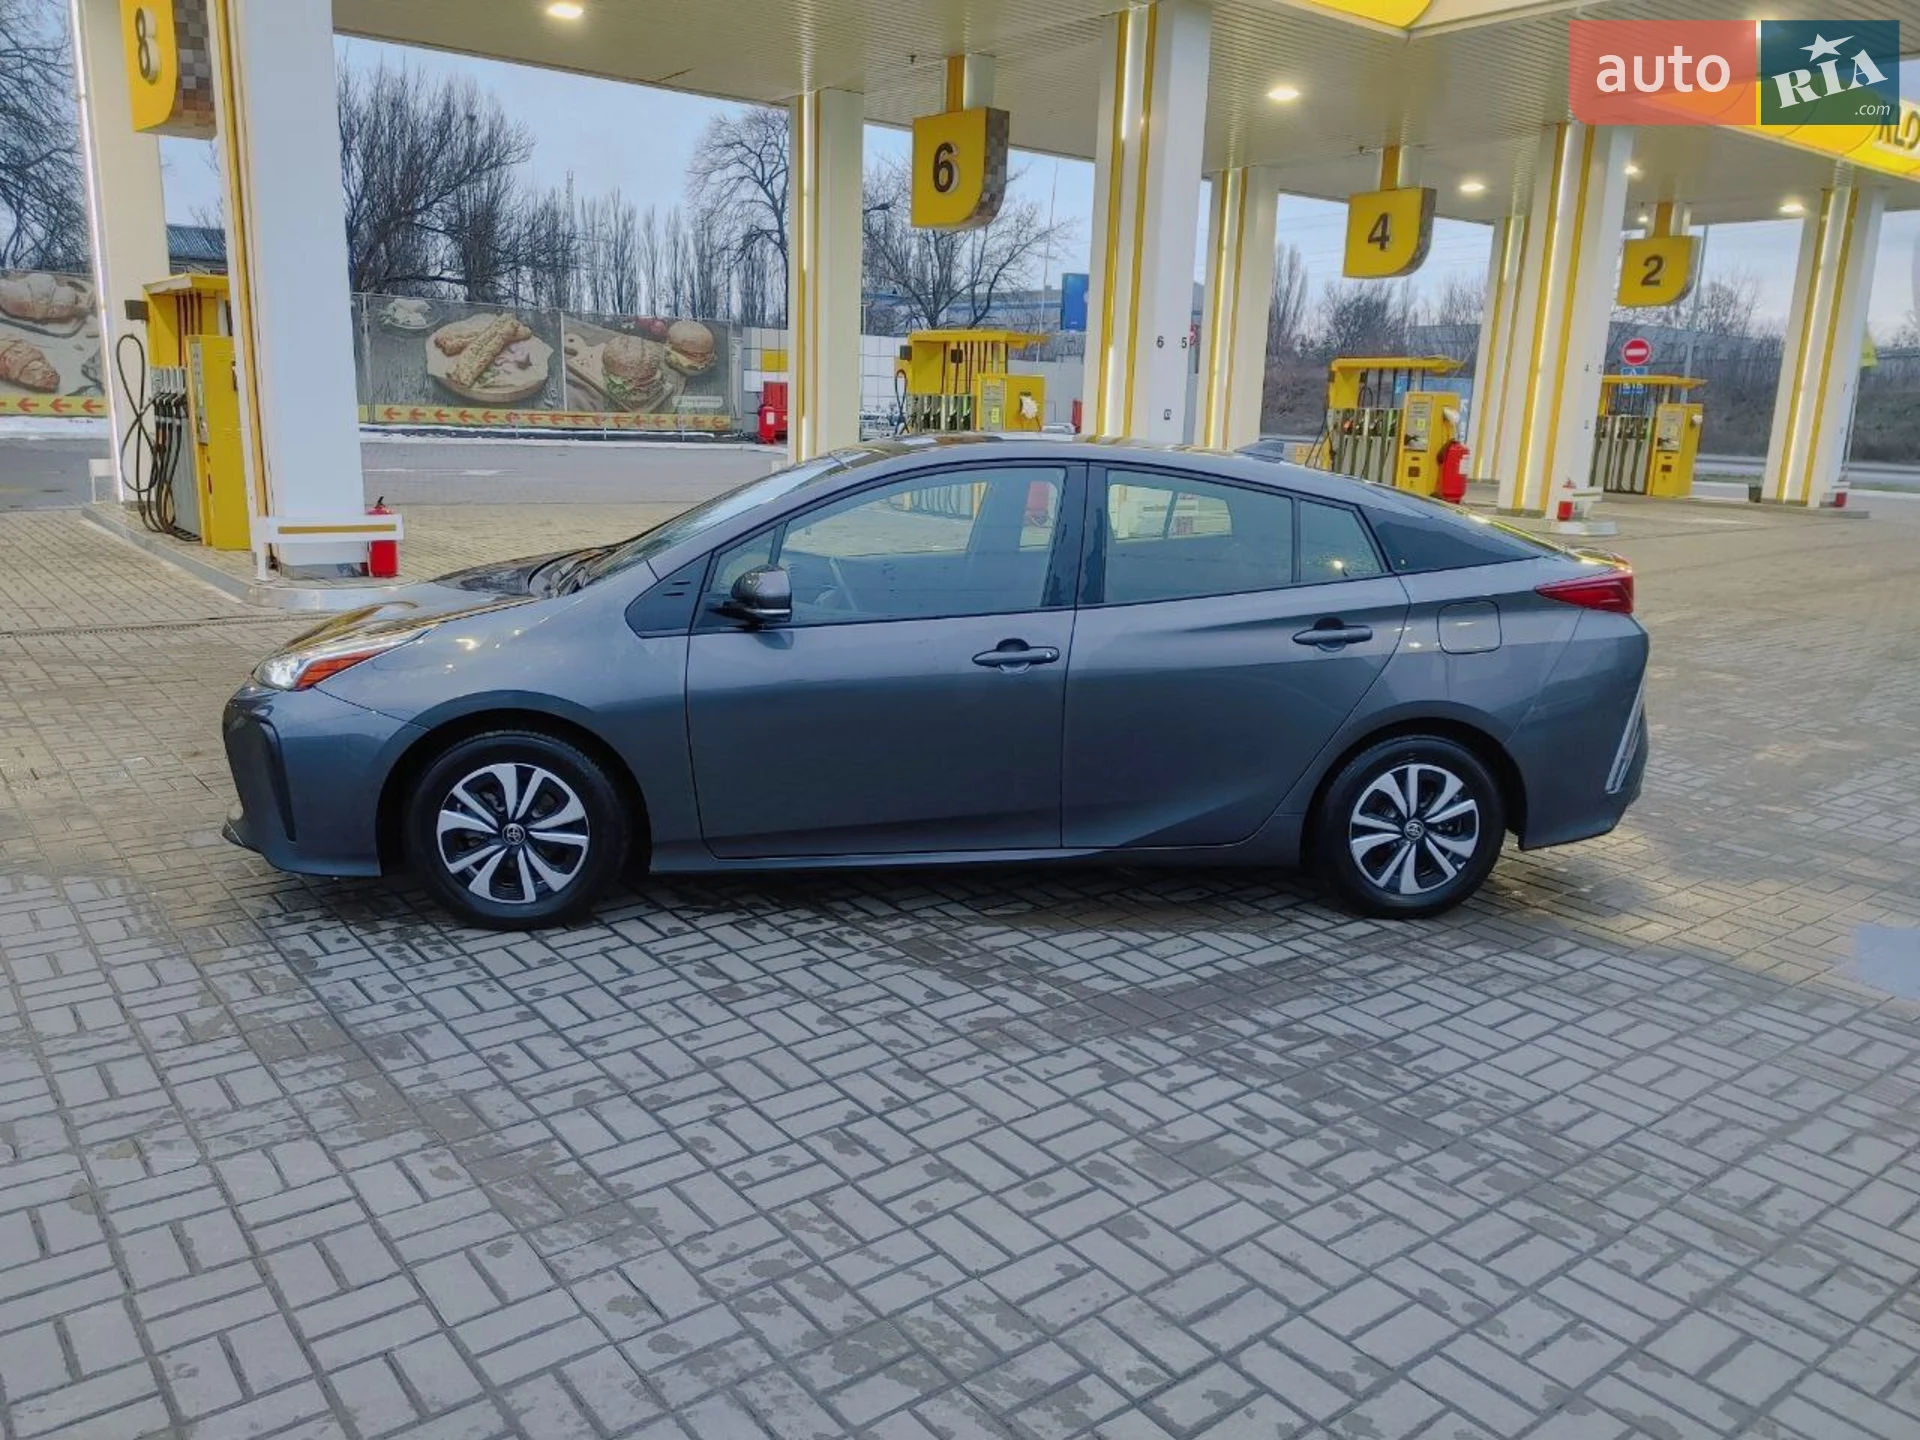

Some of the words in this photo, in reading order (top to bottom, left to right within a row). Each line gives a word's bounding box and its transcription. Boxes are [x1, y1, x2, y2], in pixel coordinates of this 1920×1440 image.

[135, 7, 155, 82] 8
[933, 142, 957, 193] 6
[1367, 212, 1390, 251] 4
[1641, 254, 1664, 286] 2
[1156, 335, 1164, 348] 6
[1181, 337, 1188, 349] 5
